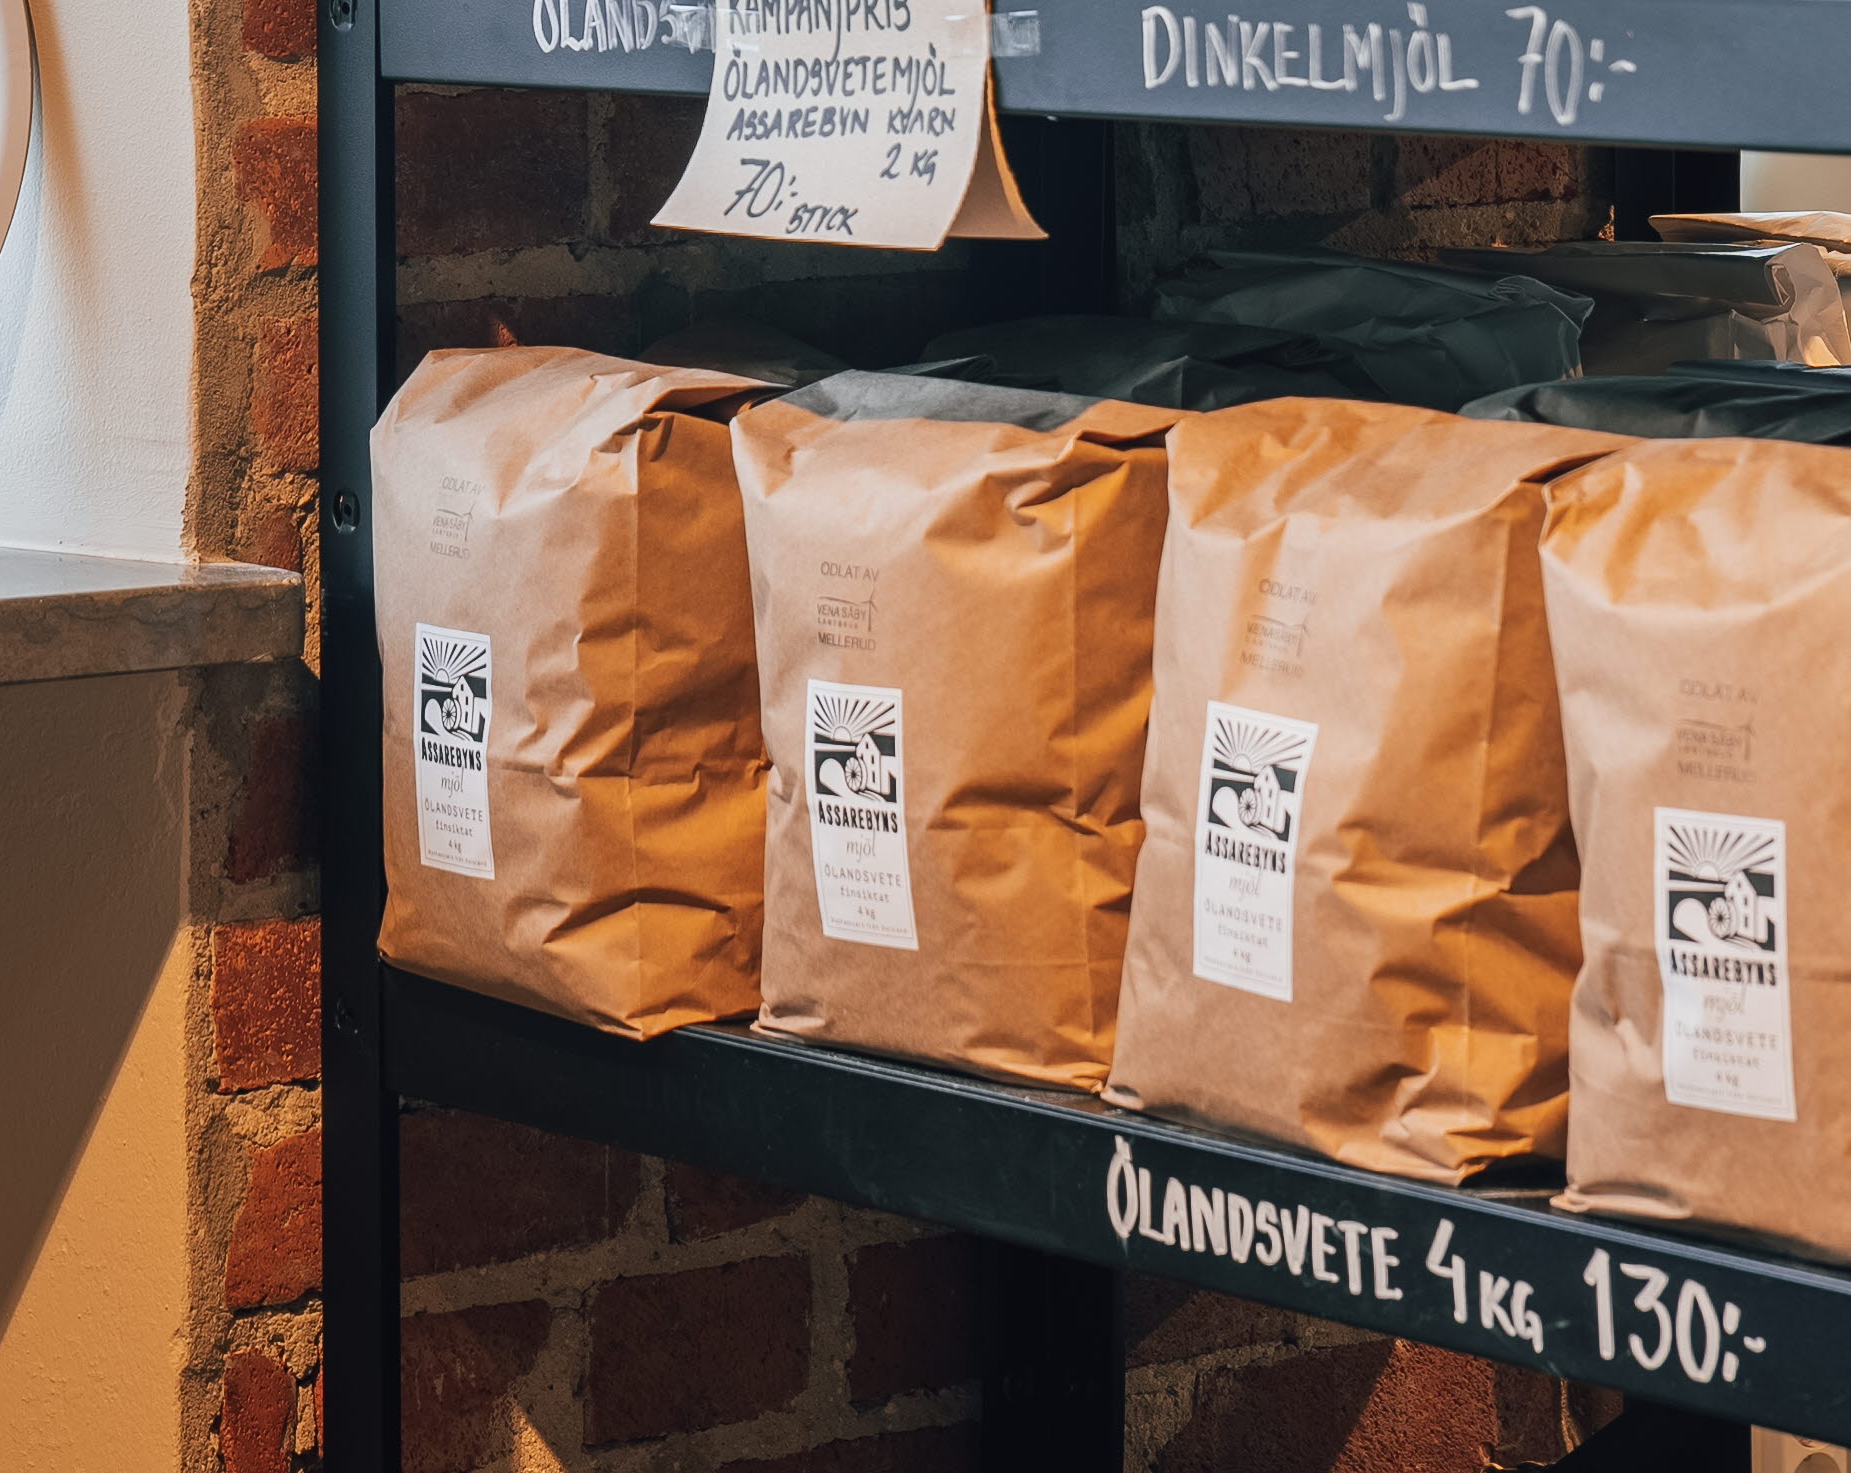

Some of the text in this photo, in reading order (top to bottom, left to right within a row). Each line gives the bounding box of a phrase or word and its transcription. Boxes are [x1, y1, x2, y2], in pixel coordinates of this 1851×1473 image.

[1141, 1, 1480, 121] DINKELMJÖL
[726, 107, 870, 142] ASSAREBYN
[879, 142, 940, 187] 2 KG
[786, 202, 860, 236] STYCK
[421, 737, 482, 771] ASSAREBYNS
[818, 800, 898, 833] ASSAREBYNS
[1205, 830, 1286, 874] ASSAREBYNS
[1670, 948, 1777, 986] ASSAREBYNS
[1106, 1135, 1766, 1383] ÖLANDSVETE 4 KG 130:-
